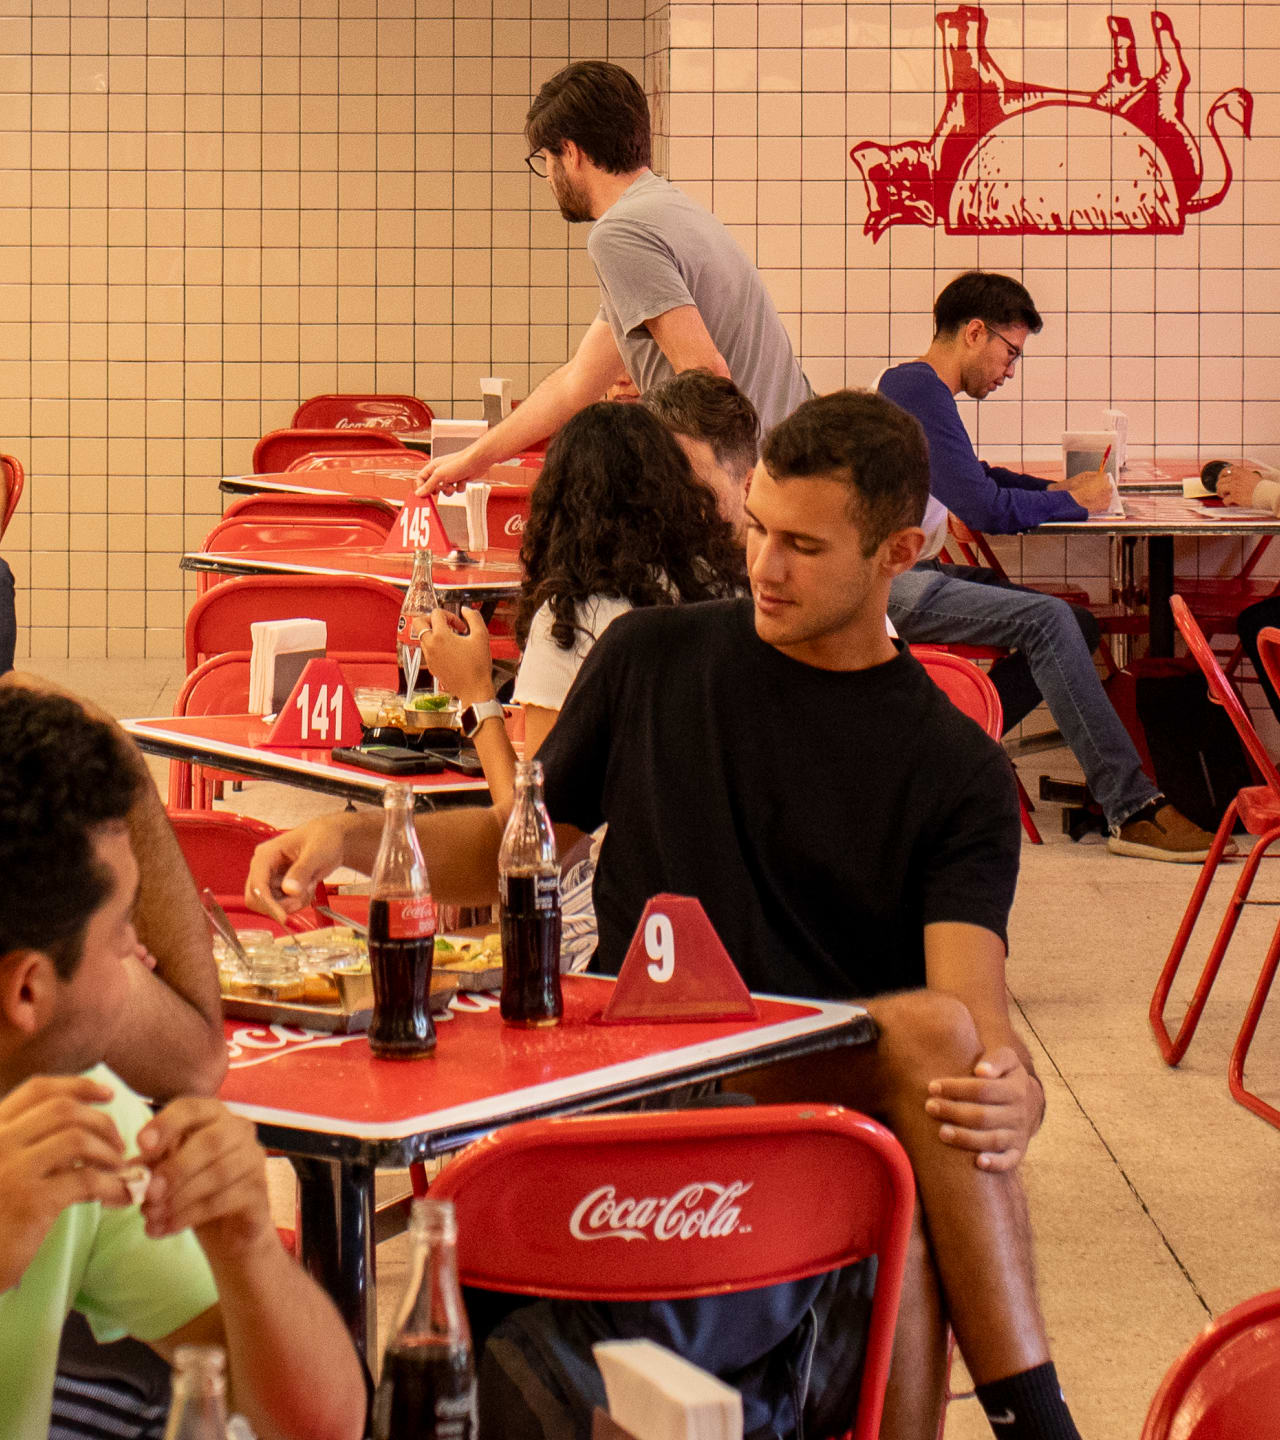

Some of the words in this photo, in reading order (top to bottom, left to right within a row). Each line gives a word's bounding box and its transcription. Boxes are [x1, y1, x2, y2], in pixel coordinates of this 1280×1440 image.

[400, 507, 430, 548] 145
[297, 683, 343, 740] 141
[644, 913, 675, 983] 9
[569, 1180, 754, 1242] Coca-Cola
